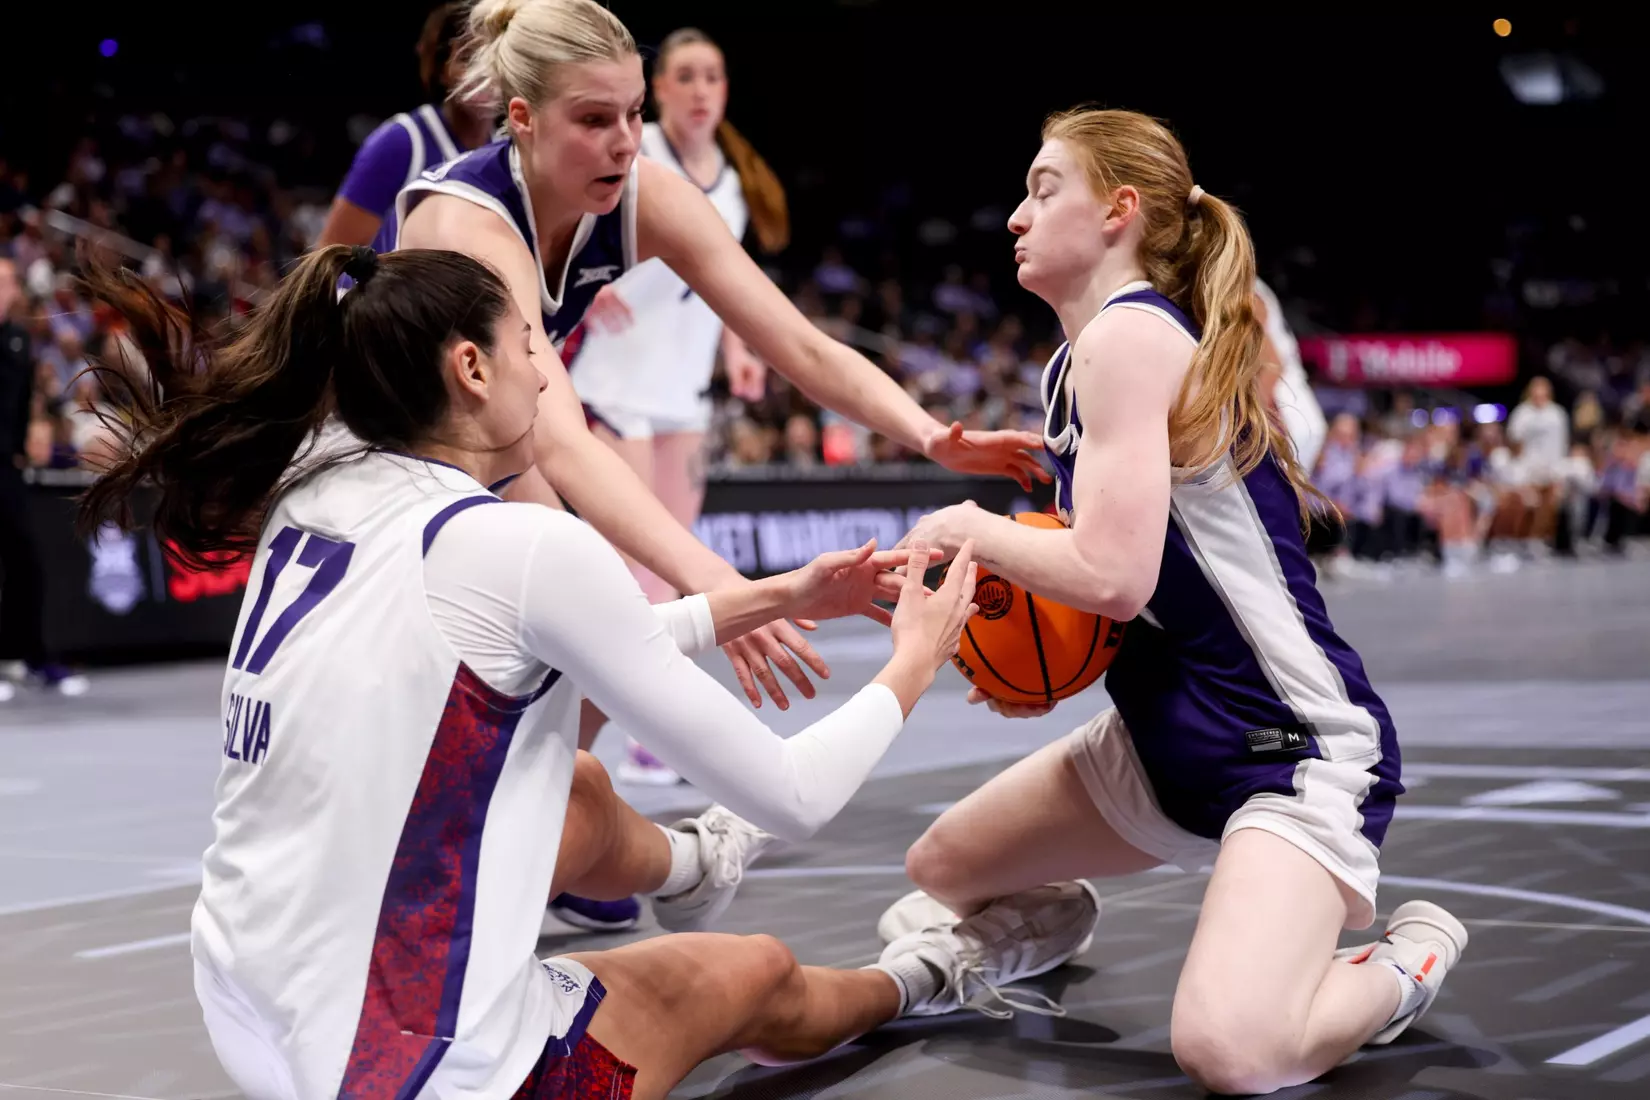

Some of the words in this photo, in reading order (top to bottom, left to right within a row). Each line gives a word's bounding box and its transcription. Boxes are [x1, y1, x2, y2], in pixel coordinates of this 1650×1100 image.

[232, 526, 355, 675] 17
[224, 693, 271, 767] SILVA
[1287, 732, 1300, 742] M
